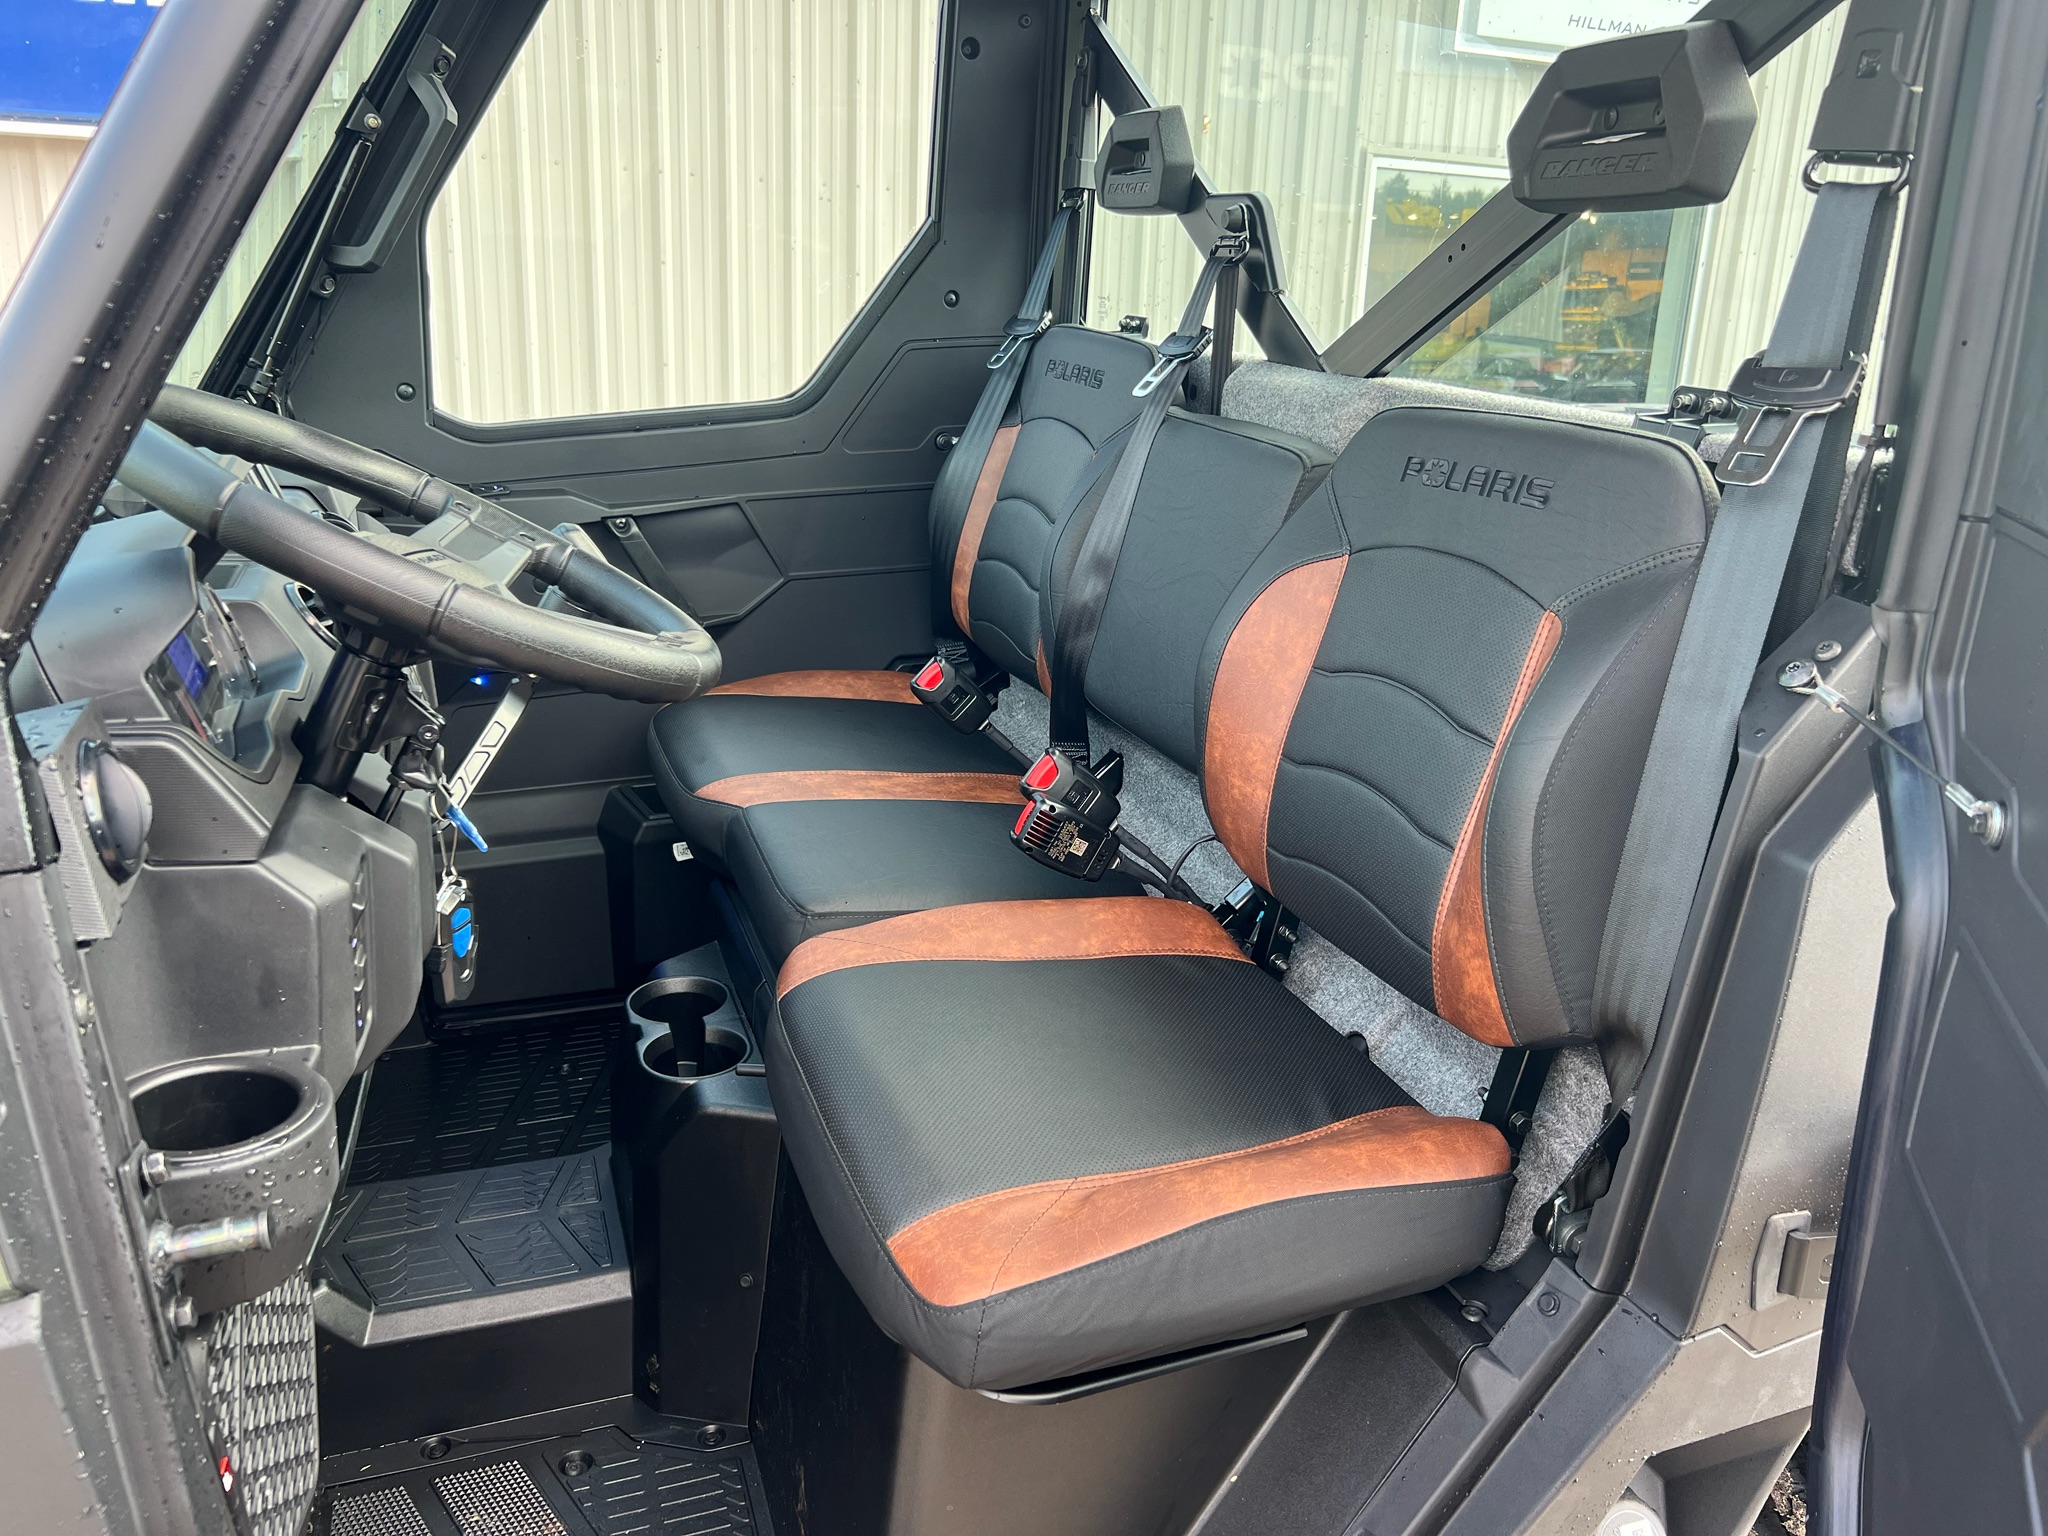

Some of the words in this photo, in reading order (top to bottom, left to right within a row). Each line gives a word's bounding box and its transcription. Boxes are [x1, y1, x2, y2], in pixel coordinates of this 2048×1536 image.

[1541, 152, 1659, 179] RANGER
[1108, 182, 1151, 194] RANGER
[1045, 359, 1105, 389] POLARIS
[1400, 456, 1555, 509] POLARIS
